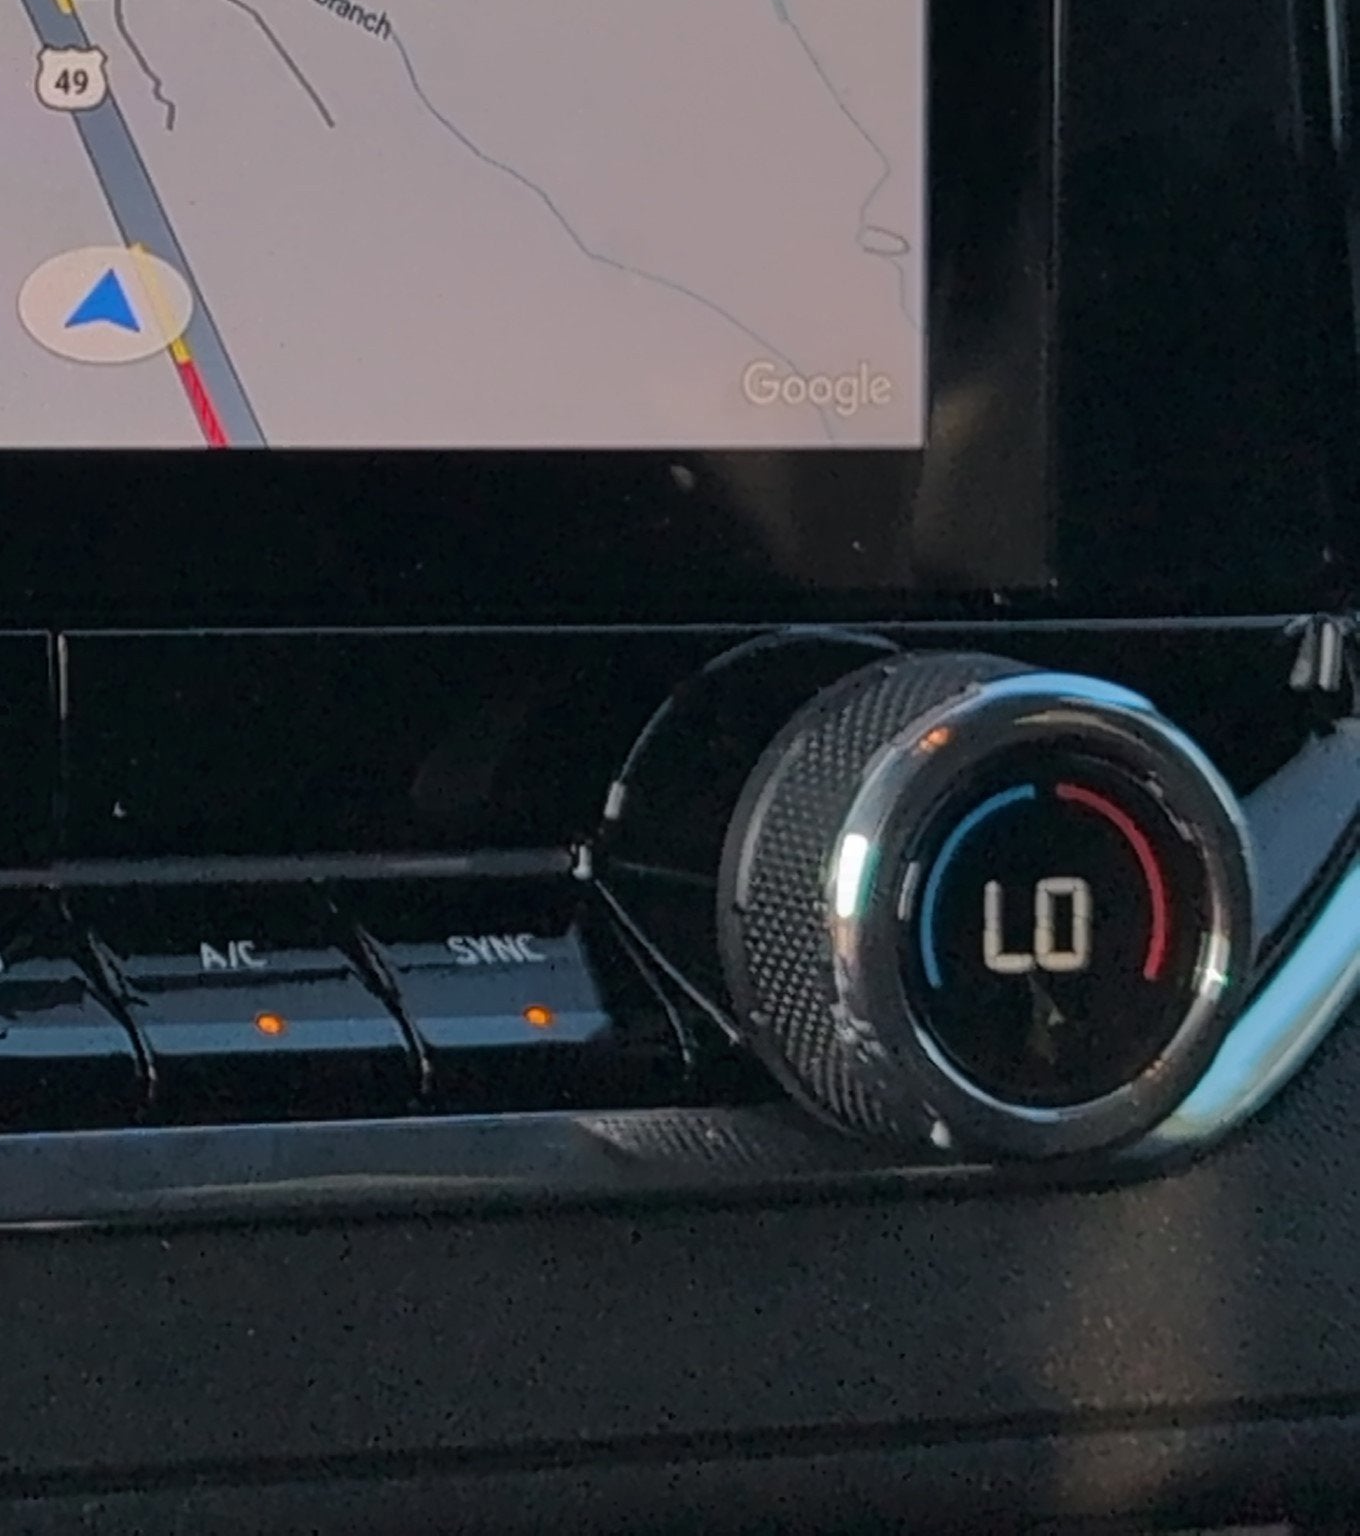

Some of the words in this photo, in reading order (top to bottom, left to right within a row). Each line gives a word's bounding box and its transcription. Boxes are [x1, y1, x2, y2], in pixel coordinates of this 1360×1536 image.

[54, 69, 90, 96] 49
[743, 361, 892, 416] Google
[200, 940, 268, 969] A/C
[446, 933, 547, 964] SYNC
